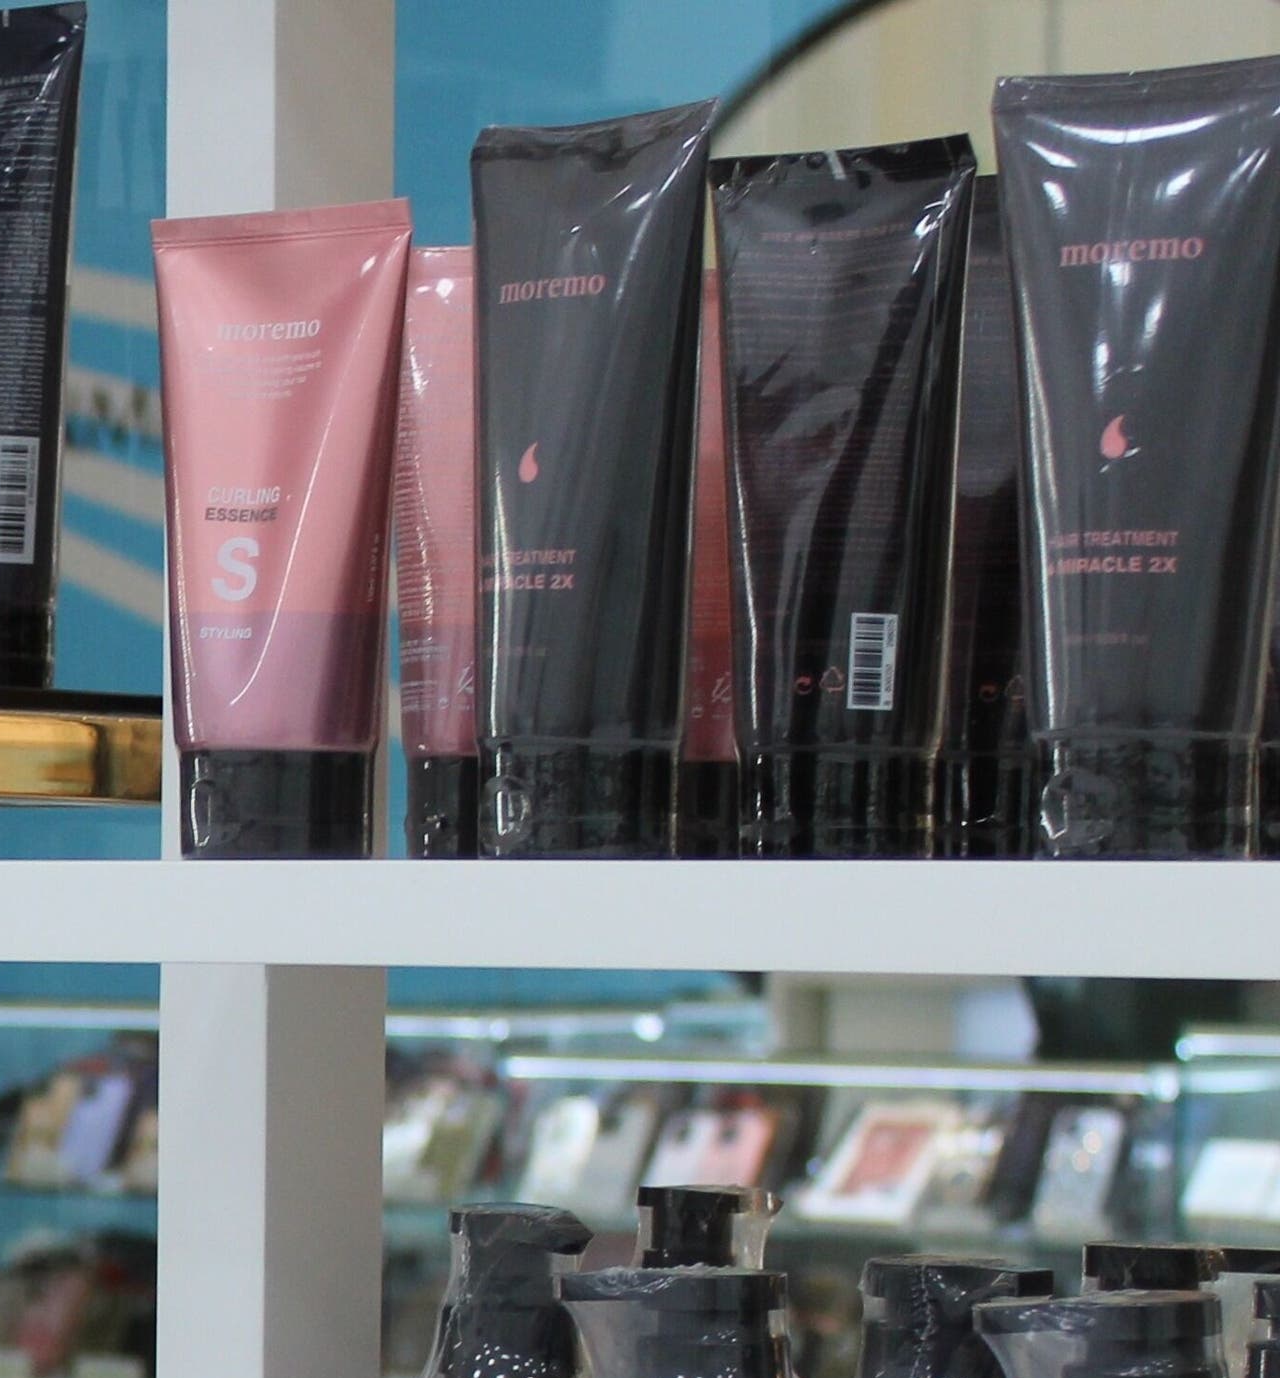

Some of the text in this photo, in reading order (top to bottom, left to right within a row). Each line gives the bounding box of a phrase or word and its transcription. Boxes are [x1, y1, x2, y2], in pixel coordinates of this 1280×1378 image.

[1060, 236, 1205, 268] moremo
[498, 274, 608, 305] moremo
[218, 318, 322, 341] moremo
[207, 486, 281, 505] CURLING
[205, 507, 280, 522] ESSENCE
[1083, 530, 1180, 547] TREATMENT
[210, 536, 260, 602] S
[1057, 556, 1179, 575] MIRACLE 2X
[550, 574, 576, 590] 2X
[200, 627, 253, 641] STYLING
